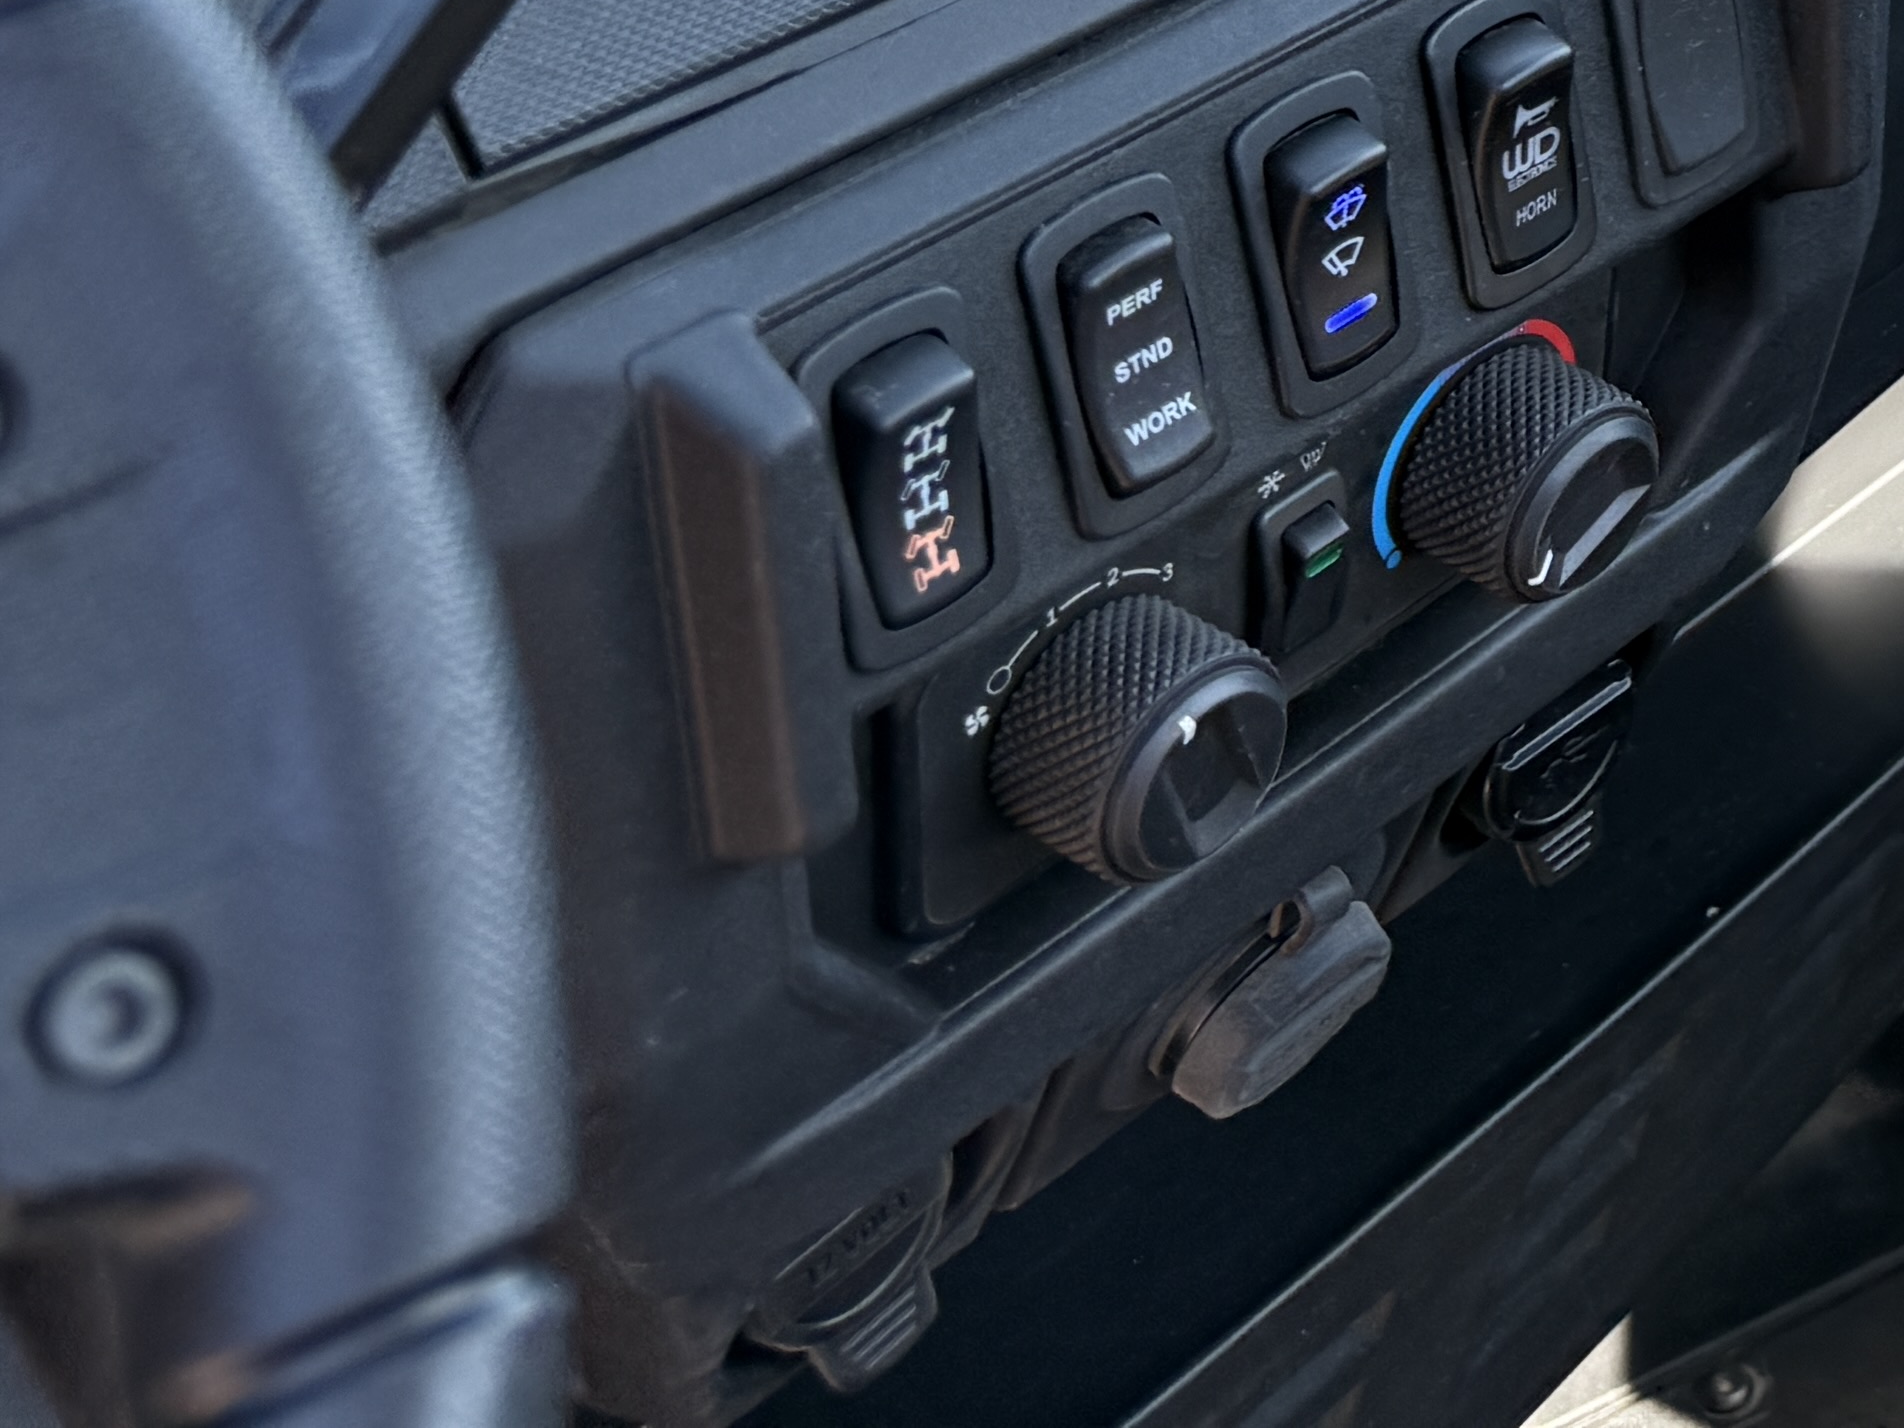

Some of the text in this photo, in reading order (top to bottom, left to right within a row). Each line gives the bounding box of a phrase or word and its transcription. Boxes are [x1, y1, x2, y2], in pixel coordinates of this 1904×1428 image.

[1502, 126, 1560, 180] WD
[1515, 188, 1558, 227] HORN
[1105, 277, 1163, 327] PERF
[1114, 336, 1174, 384] STND
[1123, 391, 1198, 446] WORK
[1045, 562, 1174, 629] 1 2 3
